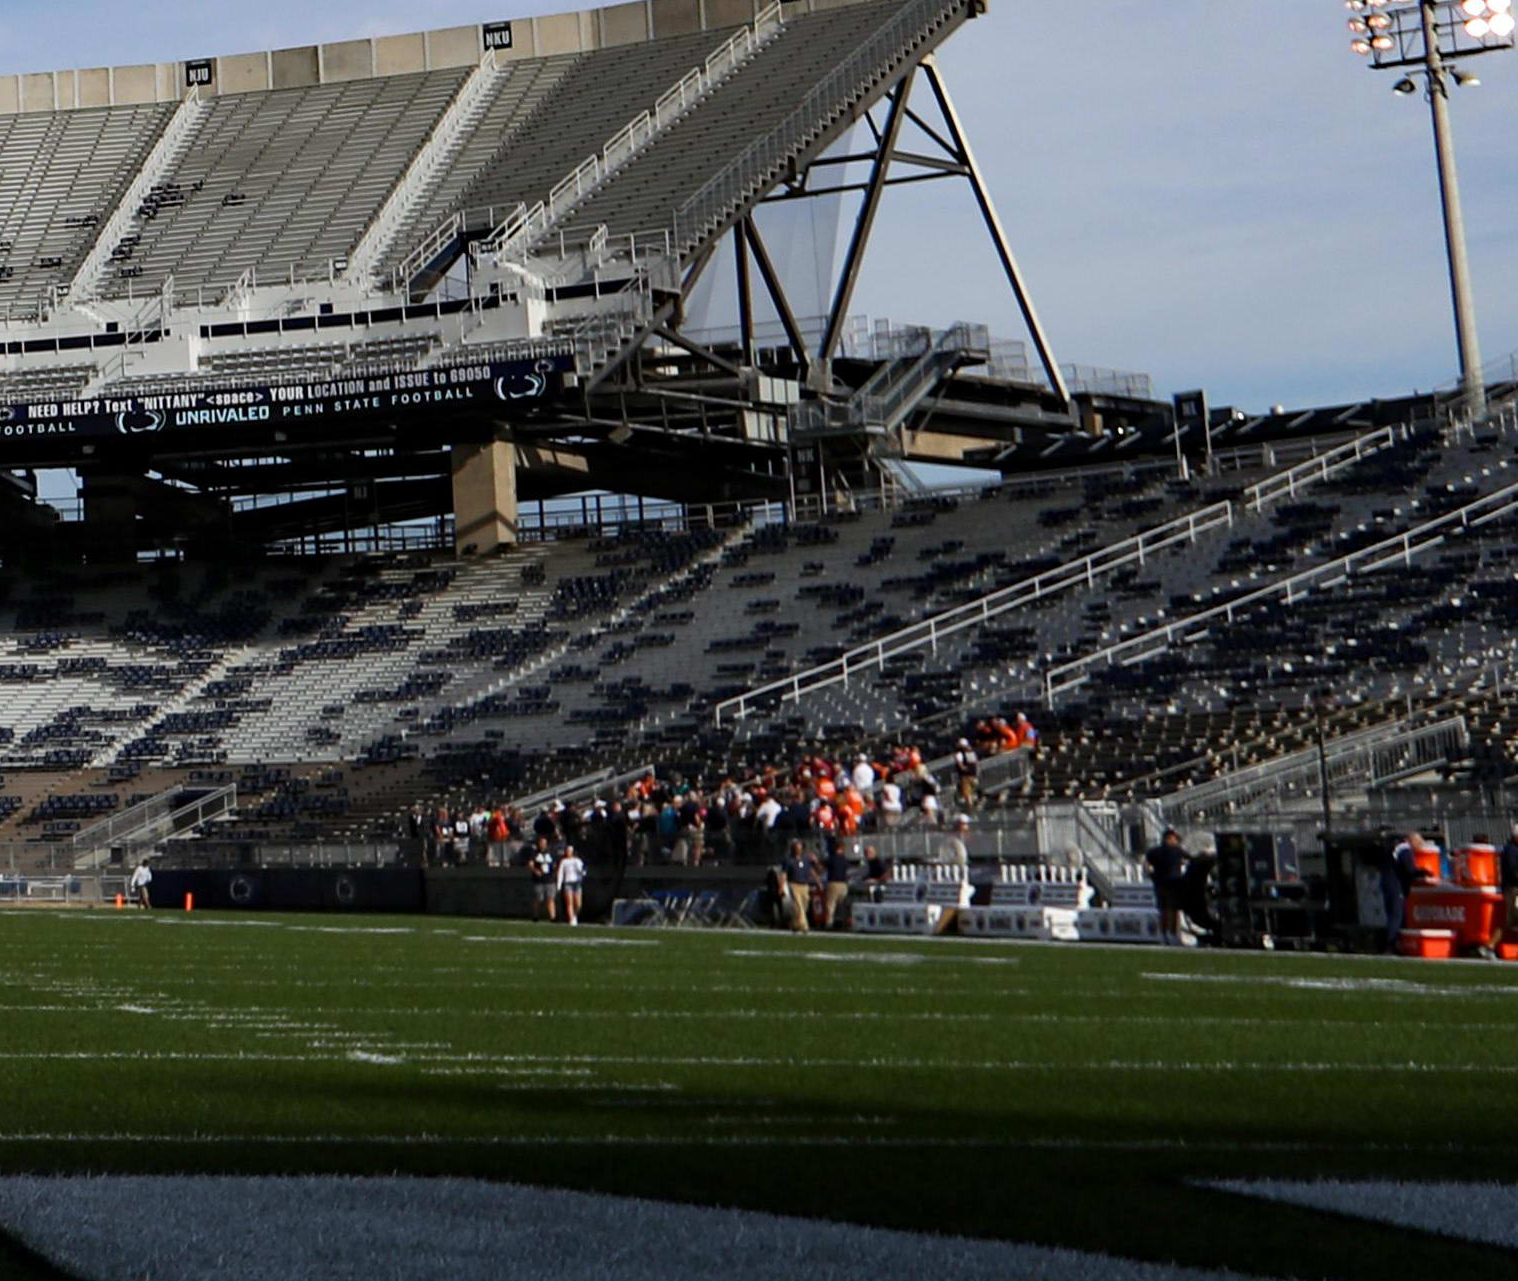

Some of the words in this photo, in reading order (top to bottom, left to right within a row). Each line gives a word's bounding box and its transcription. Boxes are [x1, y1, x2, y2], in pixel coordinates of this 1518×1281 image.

[28, 404, 59, 419] NEED
[62, 401, 100, 417] HELP?
[104, 400, 133, 413] Text
[137, 394, 205, 410] "NITTANY"
[206, 392, 264, 406] <space>
[269, 386, 304, 402] YOUR
[307, 380, 365, 399] LOCATION
[368, 377, 391, 392] and
[394, 373, 429, 389] ISSUE
[433, 371, 447, 384] to
[450, 366, 491, 383] 69050
[175, 406, 270, 426] UNRIVALED
[283, 403, 324, 417] PENN
[334, 397, 380, 411] STATE
[391, 387, 474, 406] FOOTBALL
